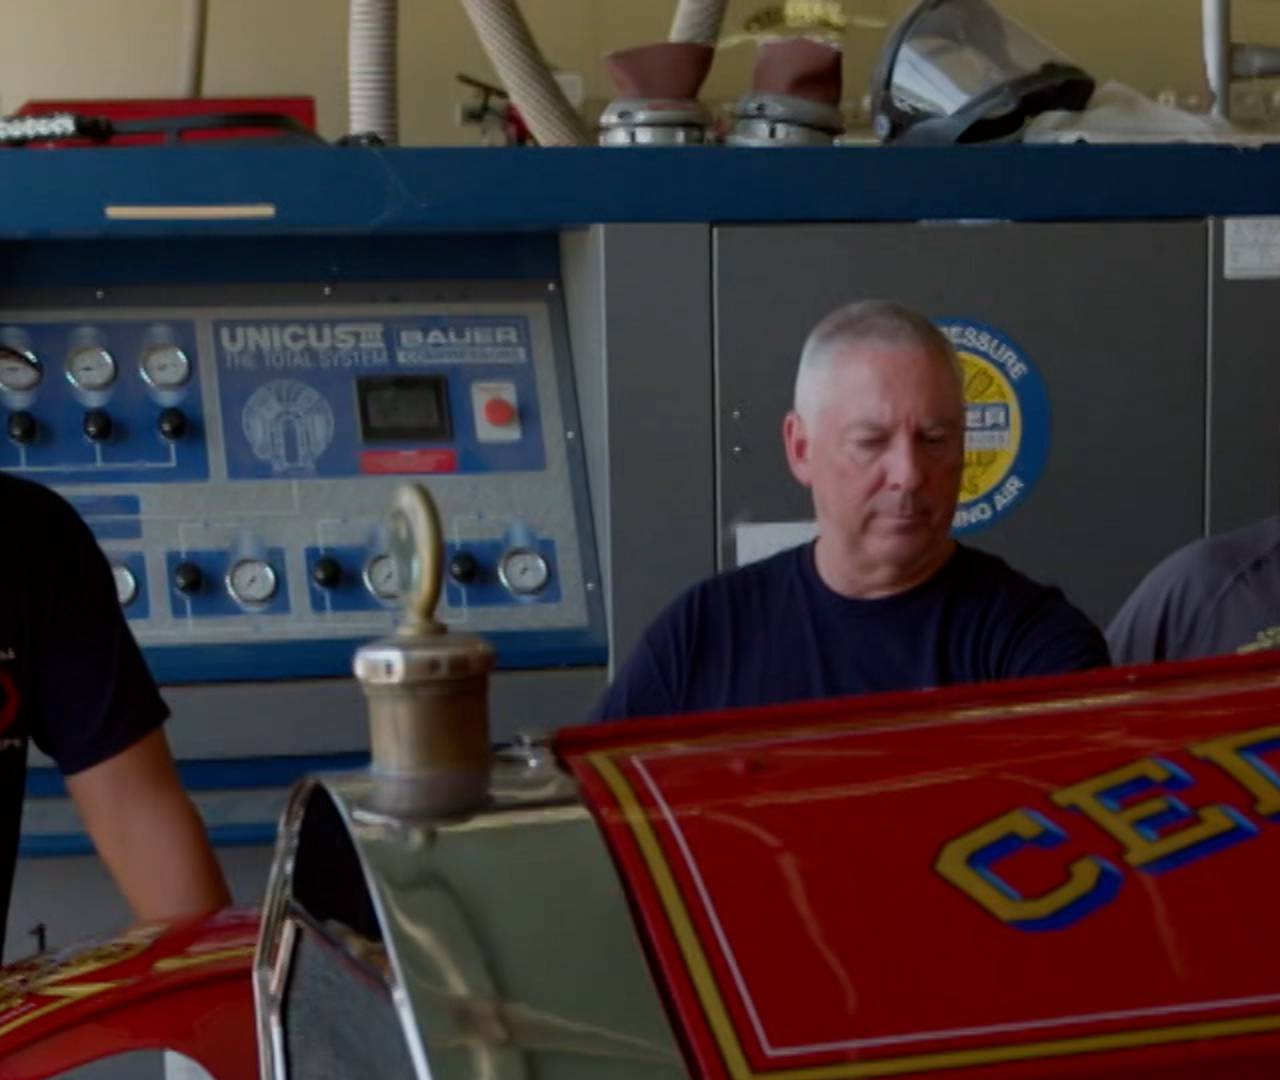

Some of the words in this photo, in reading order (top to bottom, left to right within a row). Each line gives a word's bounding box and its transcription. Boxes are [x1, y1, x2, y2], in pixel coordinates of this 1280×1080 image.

[220, 323, 357, 353] UNICUS
[399, 326, 520, 347] BAUER
[264, 349, 315, 369] TOTAL
[319, 348, 390, 369] SYSTEM
